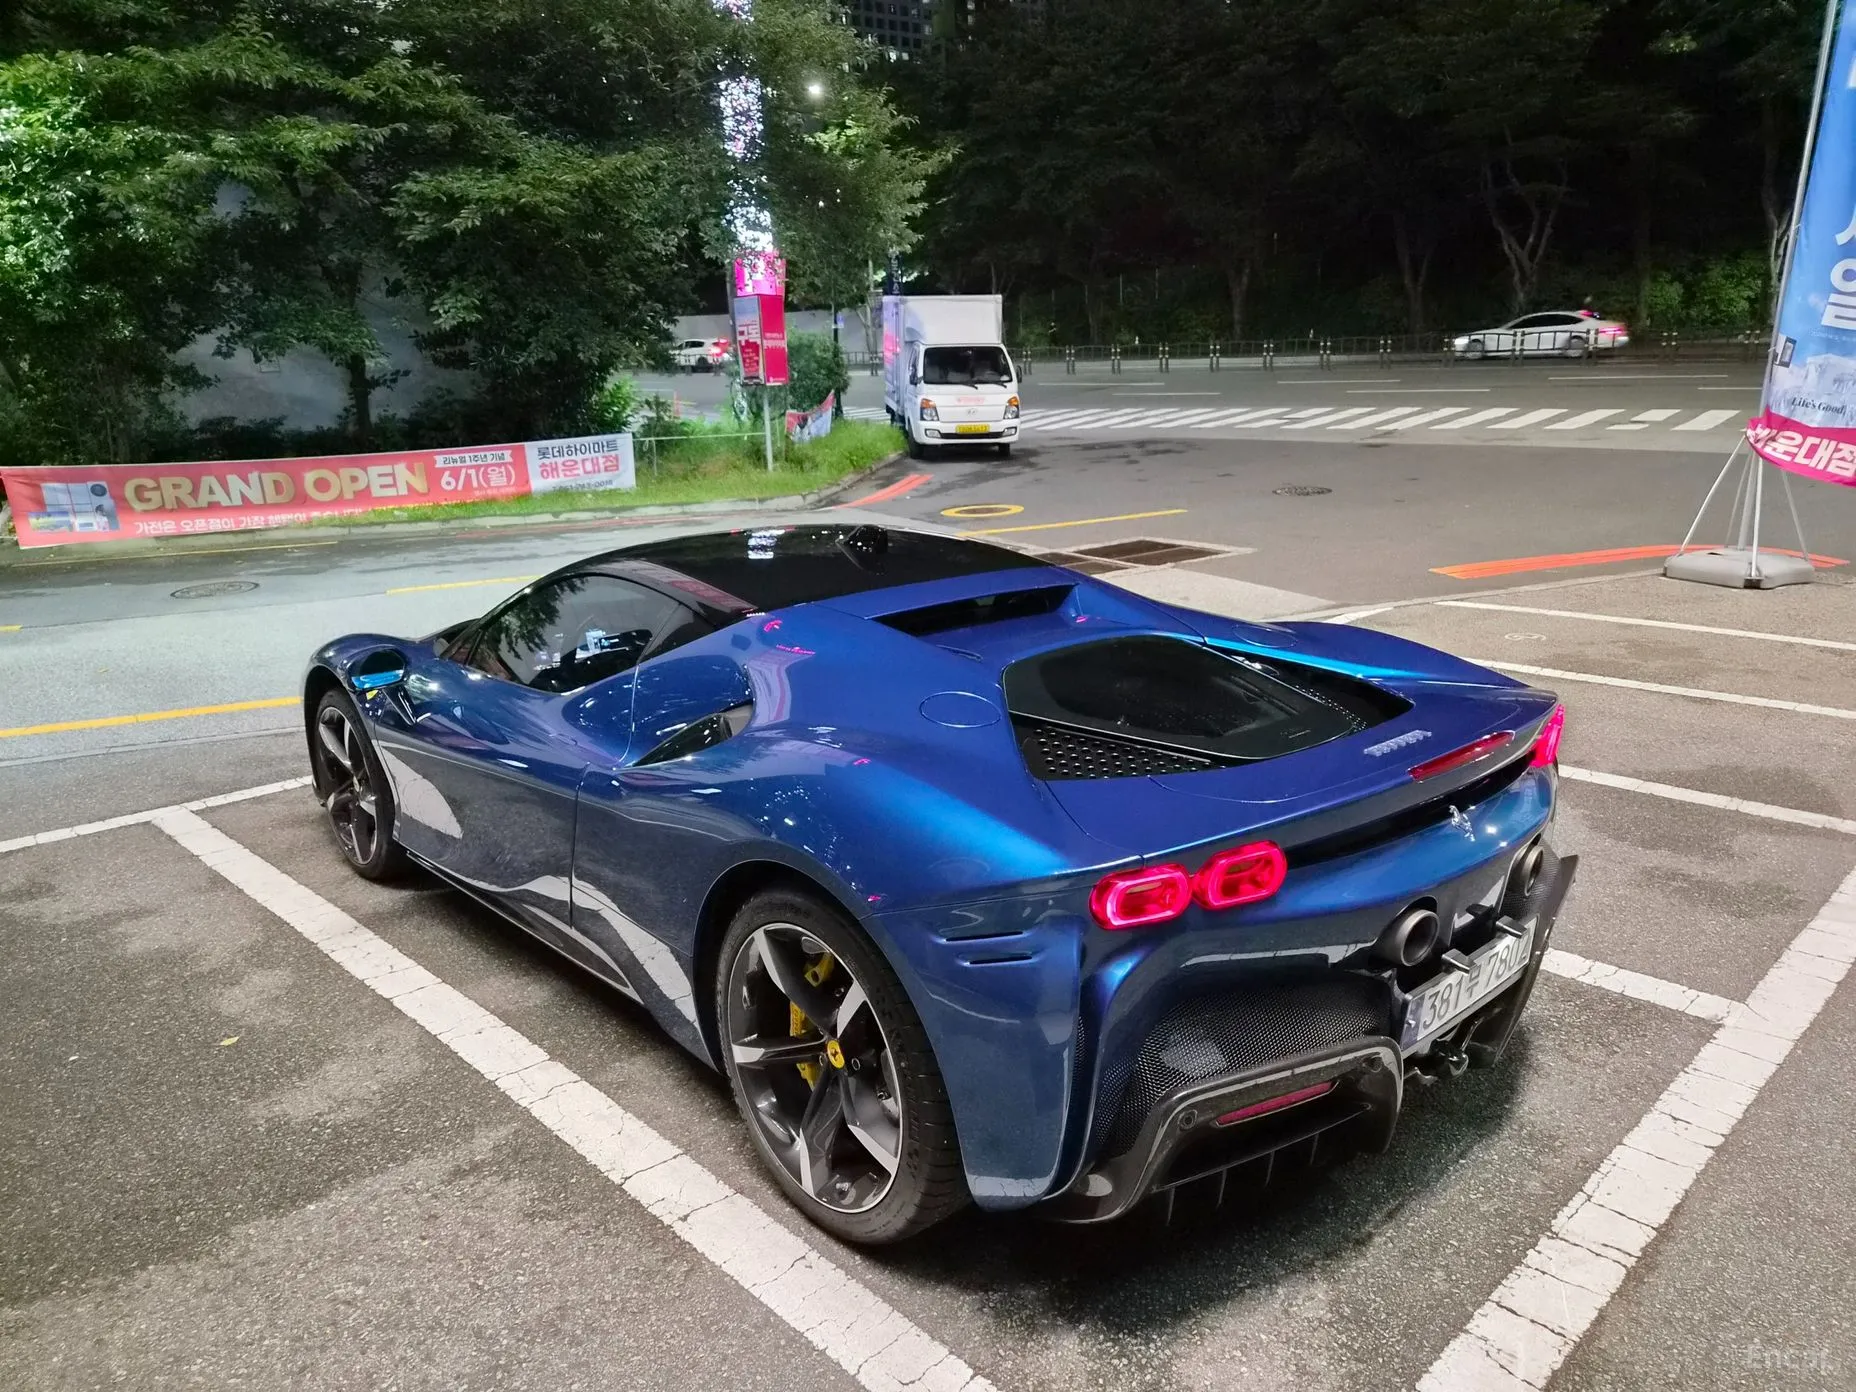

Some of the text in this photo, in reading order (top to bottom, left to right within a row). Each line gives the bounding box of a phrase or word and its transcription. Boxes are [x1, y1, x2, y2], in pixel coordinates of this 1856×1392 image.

[1791, 396, 1816, 409] Life's
[442, 452, 506, 465] 리뉴얼 1주년 기념
[537, 440, 619, 460] 롯데하이마트
[538, 454, 620, 480] 해운대점
[124, 463, 428, 511] GRAND OPEN
[440, 464, 516, 491] 6/1(월)
[134, 519, 177, 535] 가전은
[180, 517, 235, 532] 오픈점이
[238, 515, 265, 528] 가장
